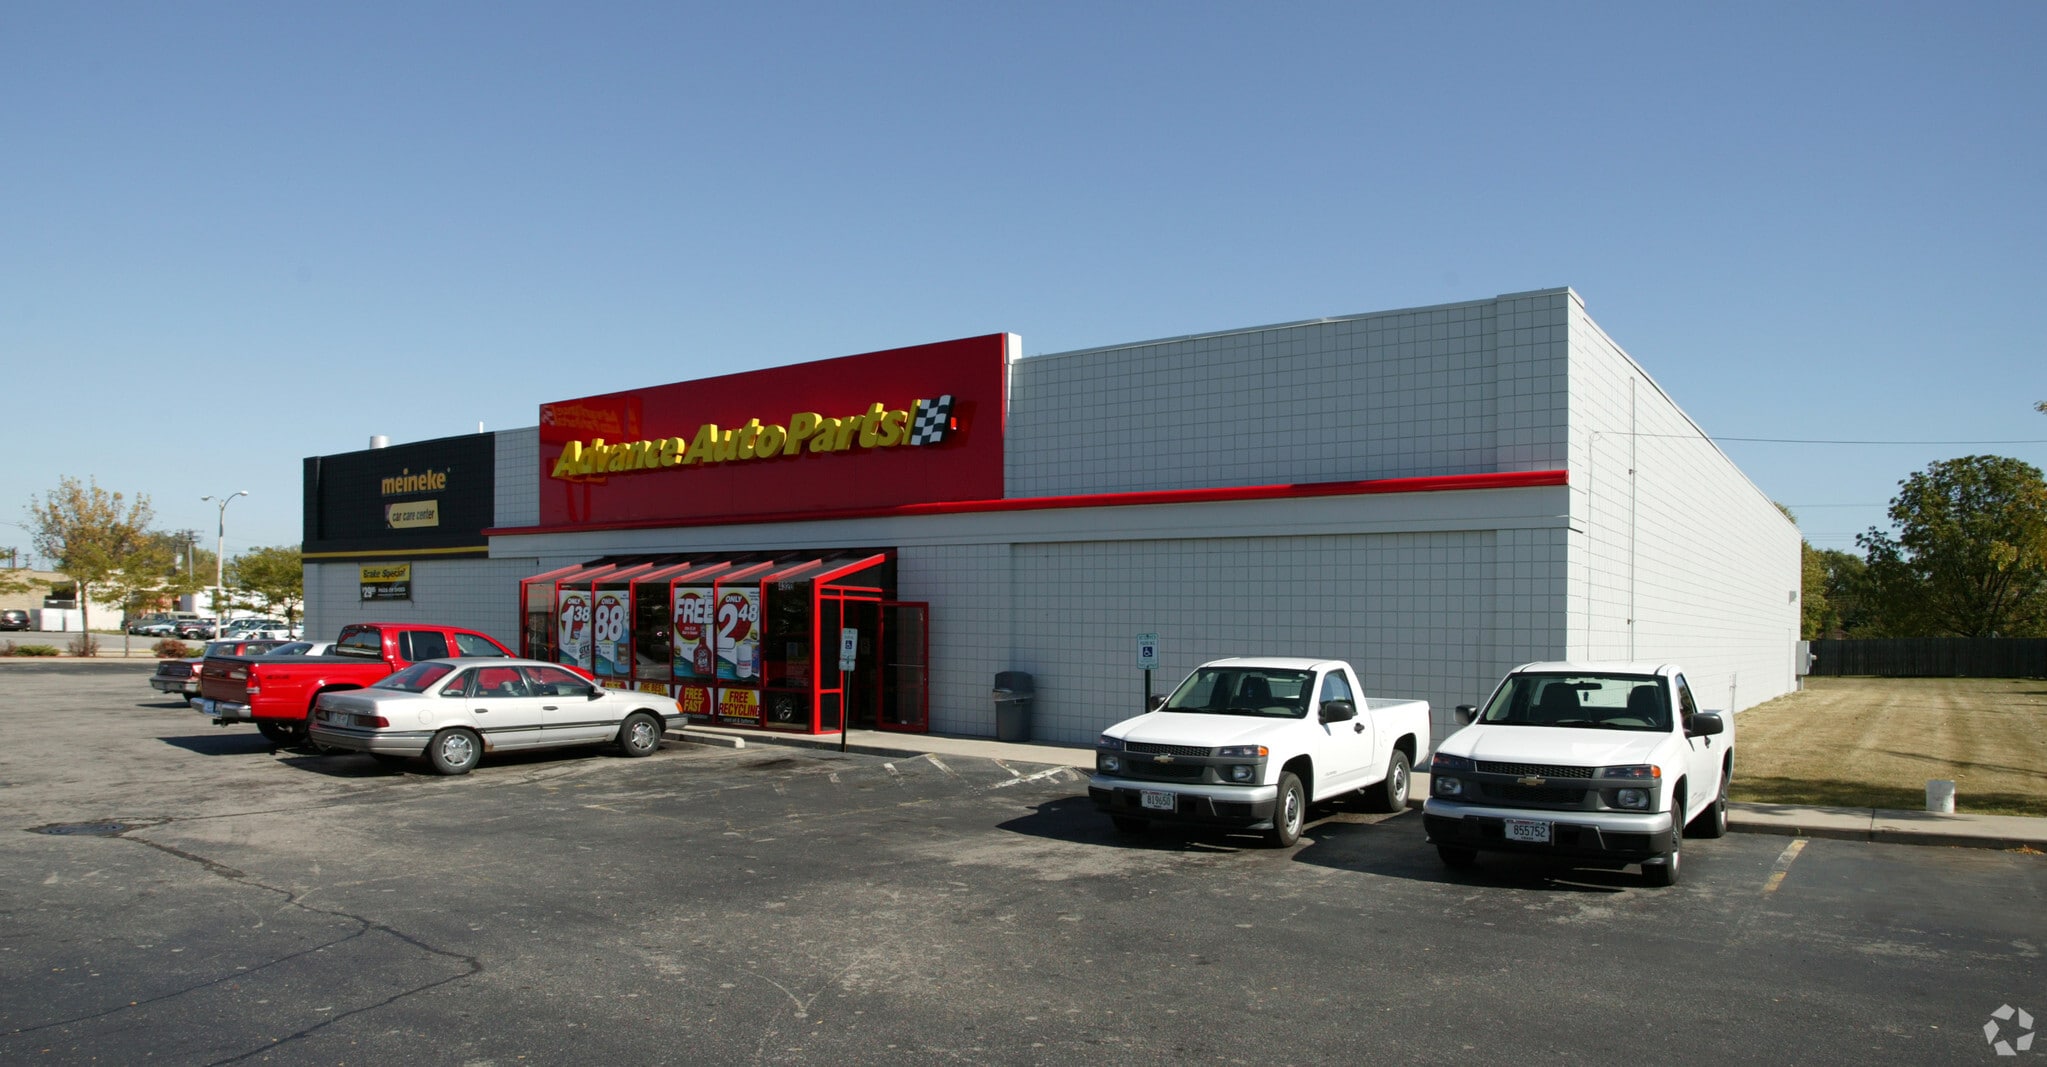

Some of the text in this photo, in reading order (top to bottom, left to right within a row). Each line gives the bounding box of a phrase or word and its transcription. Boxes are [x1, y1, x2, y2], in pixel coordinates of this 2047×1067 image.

[551, 402, 910, 478] Advance Auto Parts
[382, 467, 446, 496] meineke
[392, 508, 435, 522] car care center
[725, 595, 743, 603] ONLY
[674, 598, 713, 624] FREE
[595, 605, 624, 642] 88
[729, 691, 749, 703] FREE
[684, 700, 703, 713] FAST
[719, 702, 760, 717] RECYCLING
[1513, 824, 1546, 838] 855752
